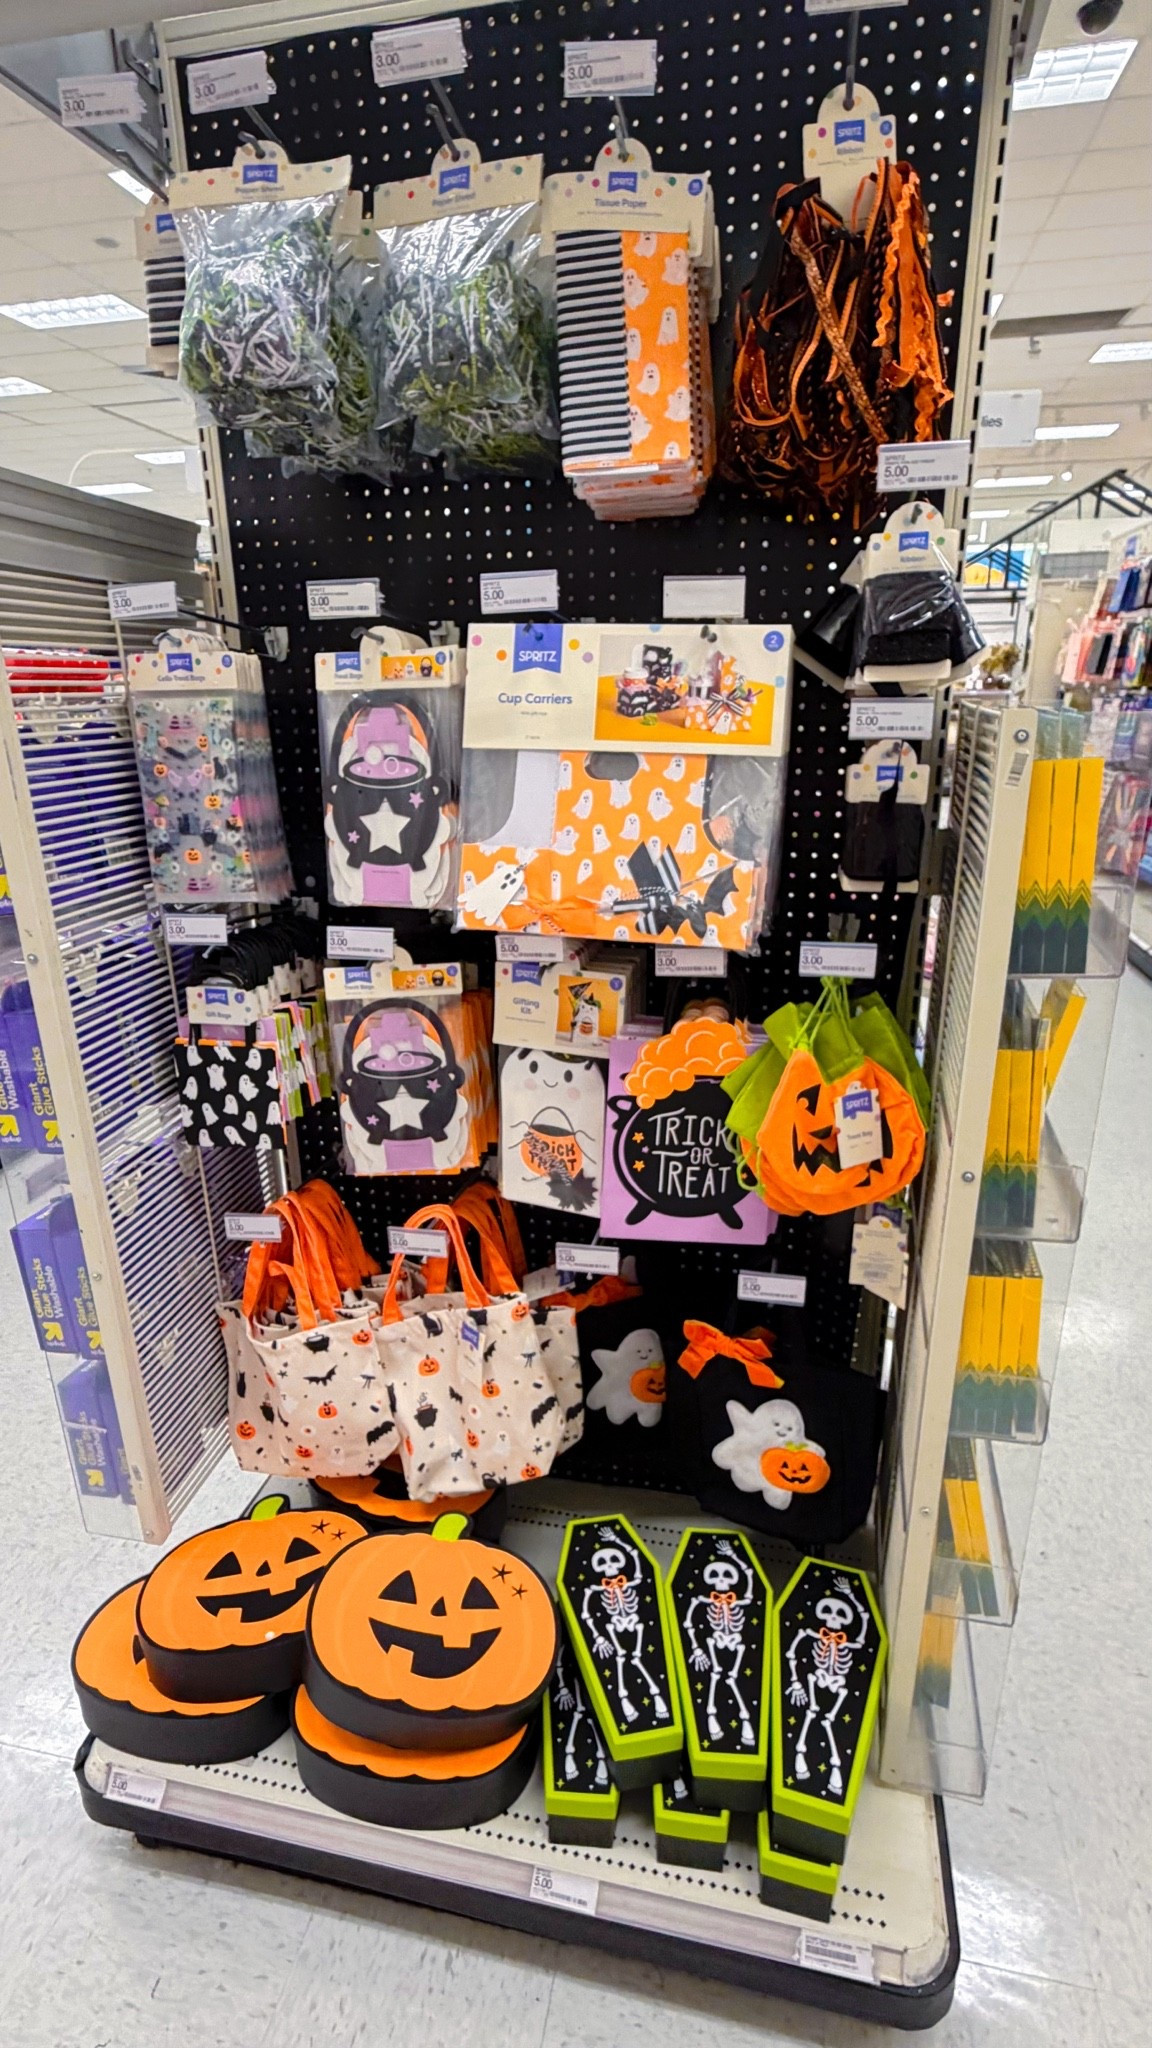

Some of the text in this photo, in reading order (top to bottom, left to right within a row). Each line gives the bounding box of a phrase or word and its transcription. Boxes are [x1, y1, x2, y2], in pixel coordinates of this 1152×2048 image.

[375, 53, 400, 68] 3.00
[567, 65, 593, 80] 3.00
[193, 83, 216, 99] 3.00
[63, 100, 86, 112] 3.00
[622, 199, 648, 209] Paper
[883, 465, 910, 478] 5.00
[309, 596, 330, 607] 3.00
[482, 589, 505, 601] 5.00
[113, 598, 132, 609] 3.00
[769, 634, 779, 645] 2
[518, 650, 558, 663] SPRITZ
[498, 692, 573, 706] Cup Carriers
[855, 715, 879, 727] 5.00
[168, 925, 186, 935] 3.00
[329, 937, 348, 947] 3.00
[500, 943, 519, 953] 5.00
[656, 957, 677, 967] 3.00
[801, 955, 823, 966] 3.00
[0, 1049, 20, 1110] Washable
[32, 1046, 56, 1116] Glue Sticks
[28, 1082, 44, 1116] Giant
[647, 1107, 730, 1147] TRICK
[690, 1147, 719, 1168] OR
[651, 1150, 732, 1198] TREAT
[42, 1293, 54, 1318] Glue
[111, 1779, 128, 1791] 5.00
[533, 1875, 553, 1890] 5.00
